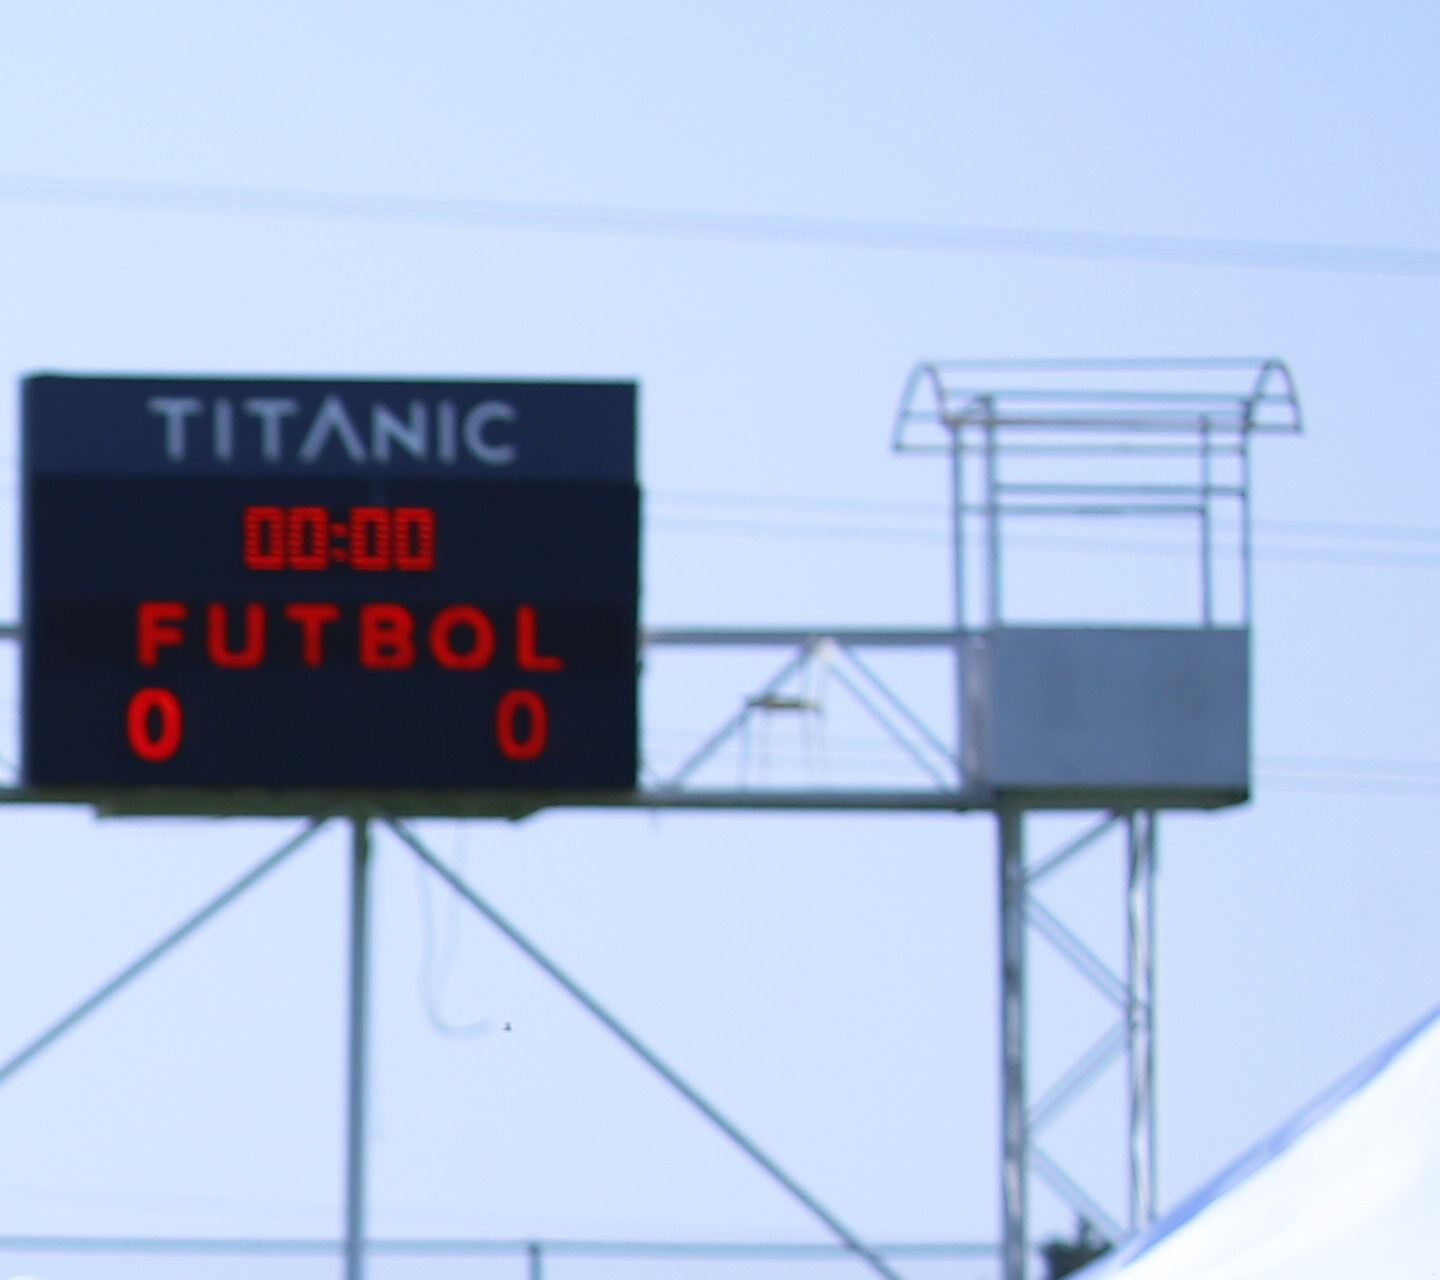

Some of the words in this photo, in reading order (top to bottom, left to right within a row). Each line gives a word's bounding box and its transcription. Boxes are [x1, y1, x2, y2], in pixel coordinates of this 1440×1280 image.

[147, 394, 517, 466] TITANIC
[243, 506, 436, 571] 00:00
[136, 601, 565, 671] FUTBOL
[126, 687, 184, 762] 0
[494, 688, 549, 761] 0
